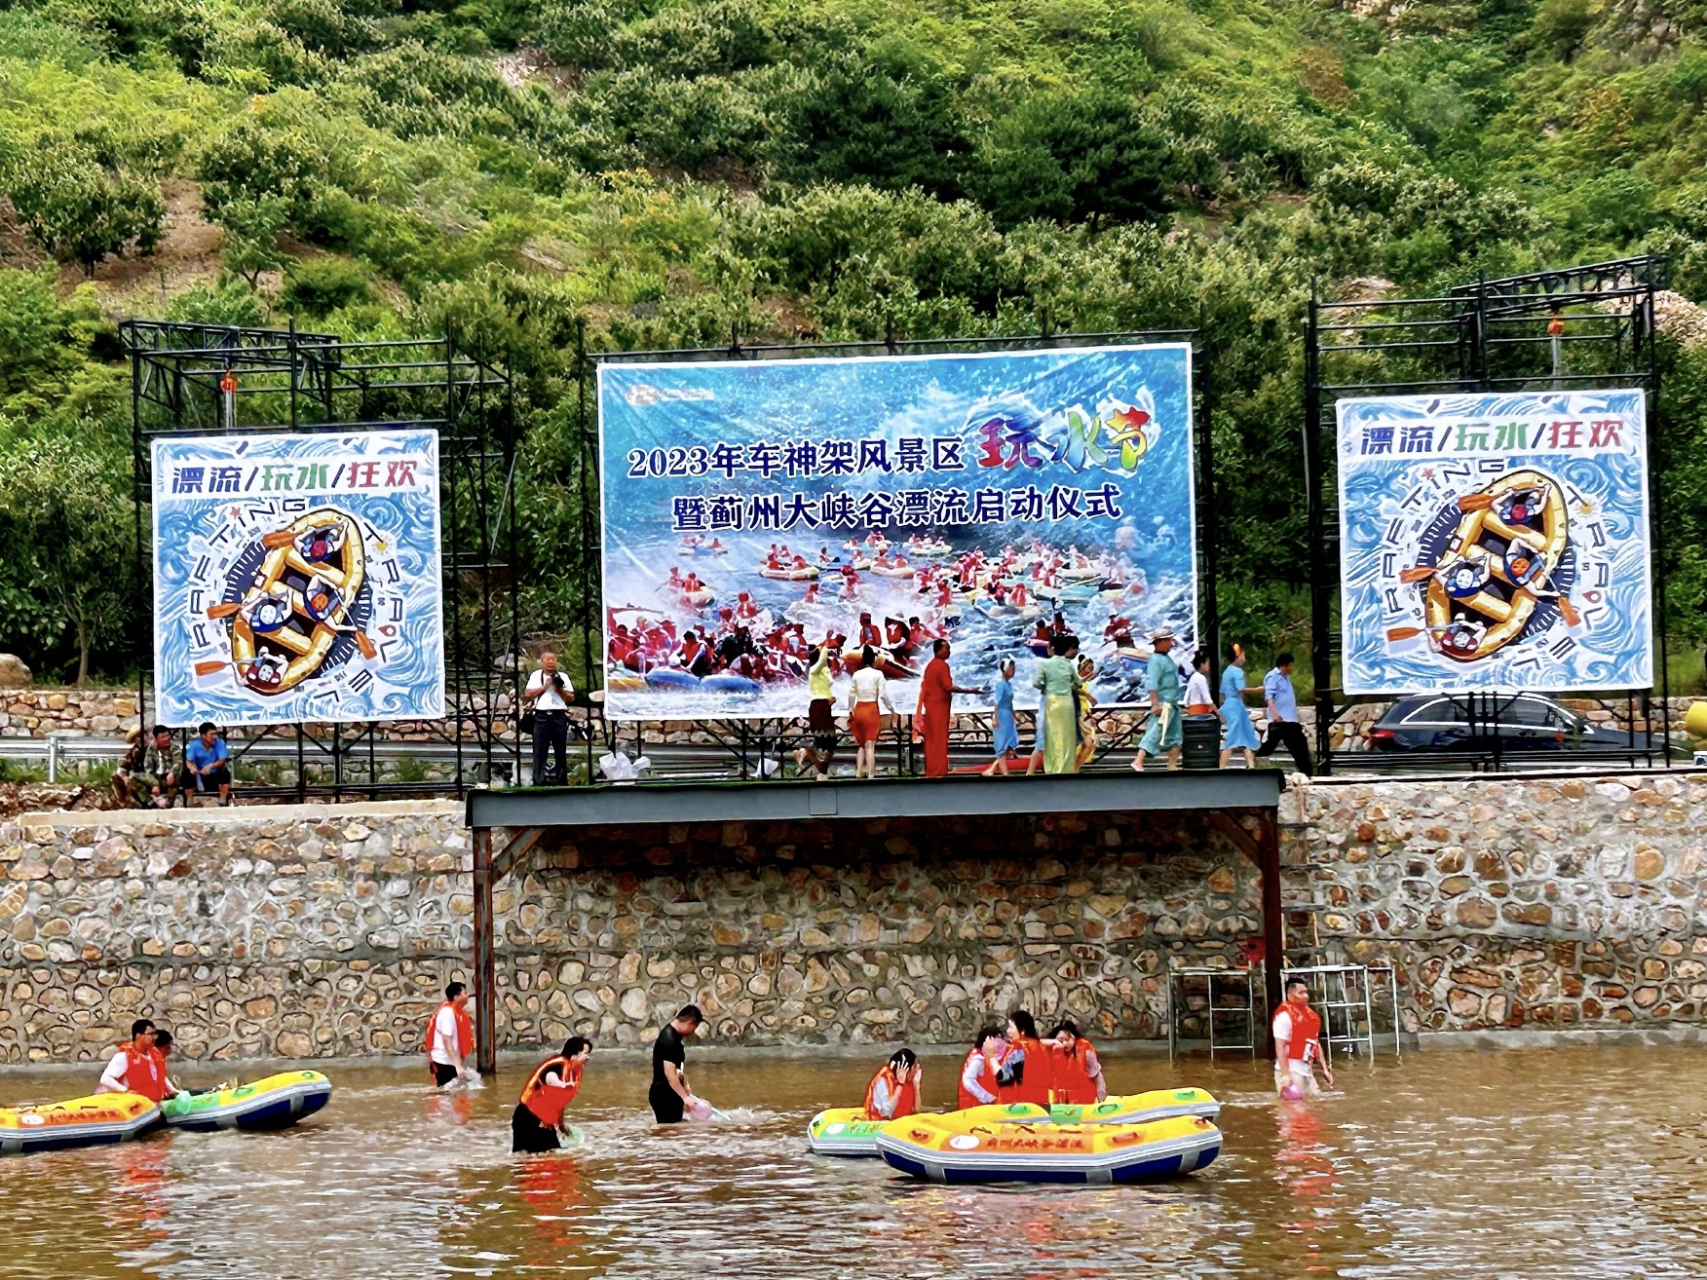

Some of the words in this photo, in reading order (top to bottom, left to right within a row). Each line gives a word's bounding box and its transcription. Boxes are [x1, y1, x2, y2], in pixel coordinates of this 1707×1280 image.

[627, 436, 966, 478] 2023年车神架风景区
[976, 405, 1152, 473] 玩水节
[1360, 419, 1624, 455] 漂流/玩水/狂欢
[171, 459, 418, 494] 漂流/玩水/狂欢
[671, 483, 1123, 532] 暨蓟州大峡谷漂流启动仪式
